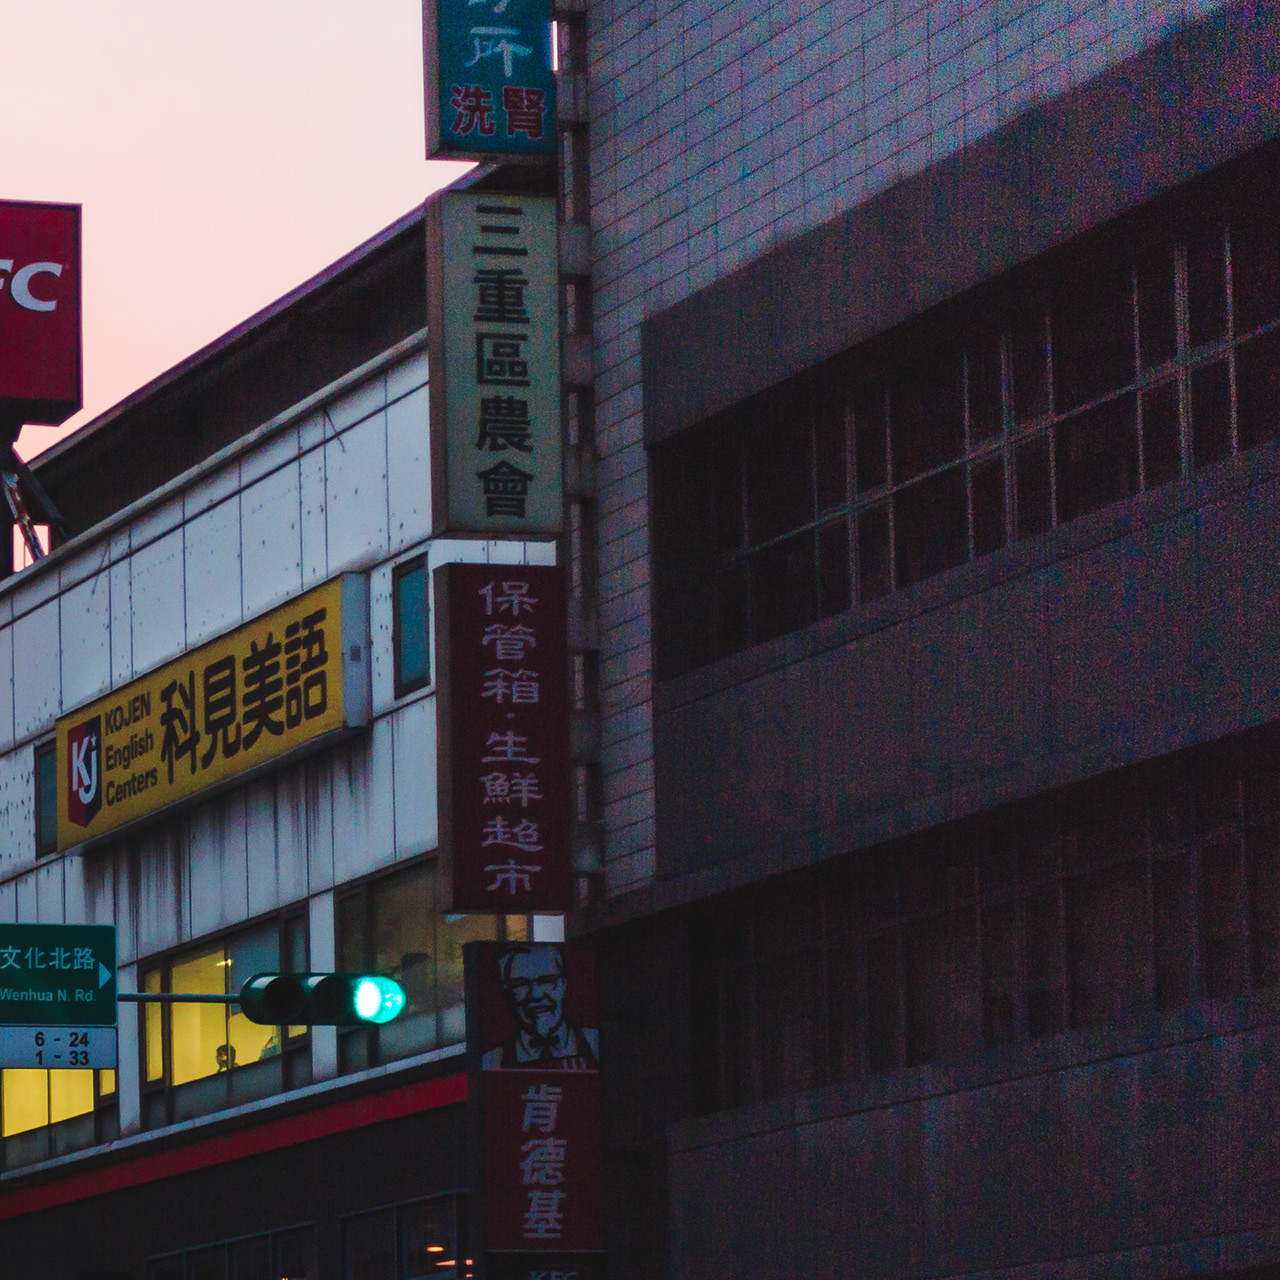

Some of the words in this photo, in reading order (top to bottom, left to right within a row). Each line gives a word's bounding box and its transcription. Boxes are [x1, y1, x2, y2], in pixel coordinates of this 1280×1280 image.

[449, 83, 546, 140] 洗腎
[473, 205, 534, 519] 三重區農會
[105, 692, 152, 736] KOJEN
[160, 607, 329, 785] 科見美語
[106, 729, 154, 772] English
[106, 767, 158, 806] Centers
[0, 945, 96, 970] 文化北路
[0, 988, 53, 1002] Wenhua
[57, 989, 71, 1002] N.
[75, 989, 97, 1002] Rd.
[69, 1032, 89, 1047] 24
[69, 1050, 90, 1066] 33
[519, 1084, 564, 1241] 肯德基
